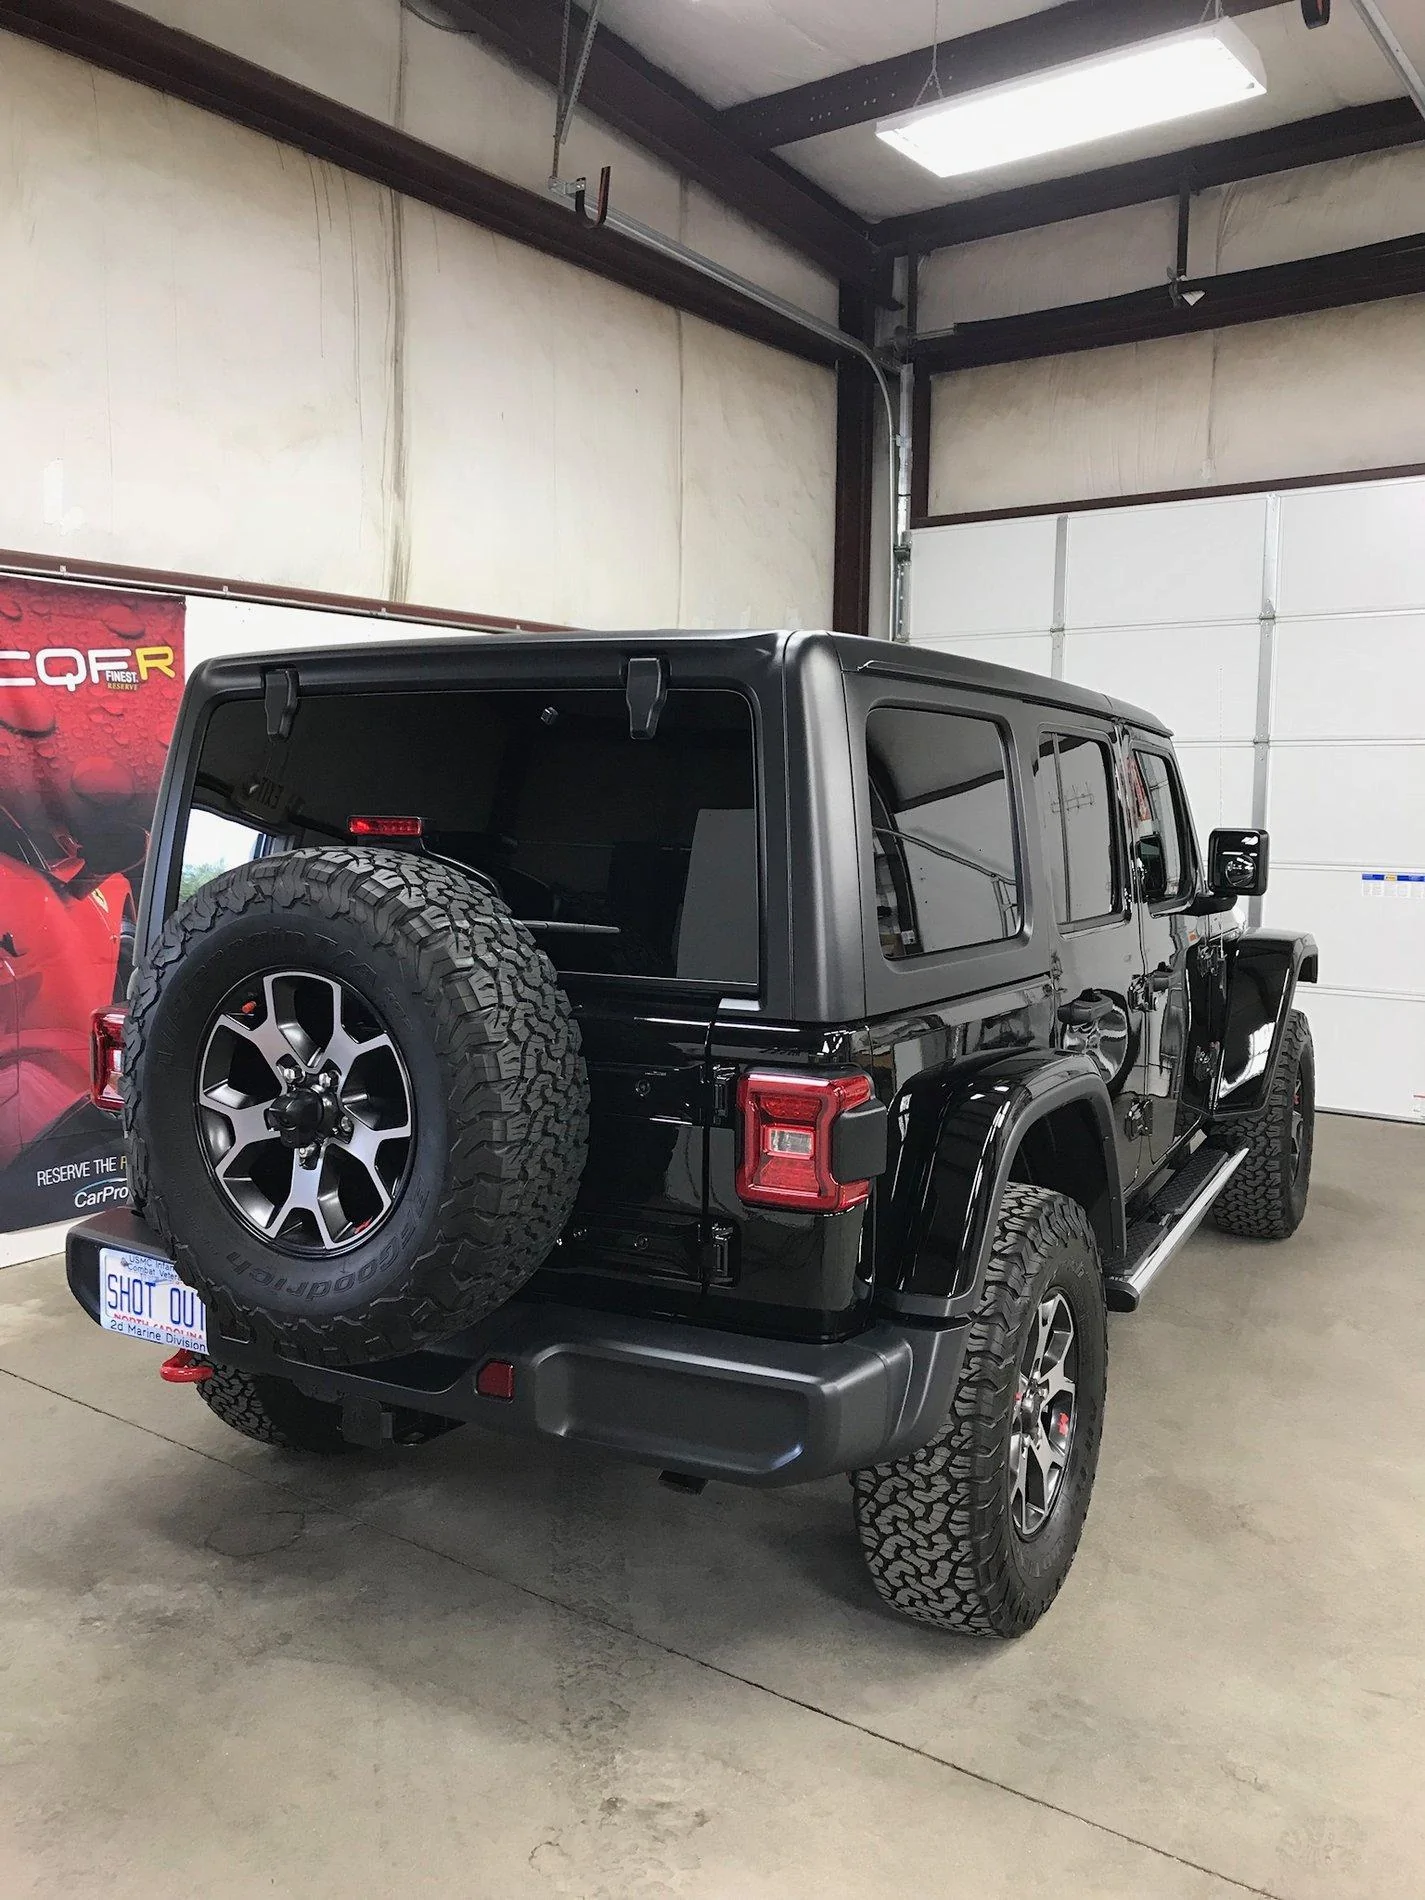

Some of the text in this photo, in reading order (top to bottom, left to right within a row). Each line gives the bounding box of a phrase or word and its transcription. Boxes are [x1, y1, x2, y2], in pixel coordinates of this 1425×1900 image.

[107, 683, 138, 691] RESERVE
[37, 1161, 90, 1187] RESERVE
[93, 1156, 117, 1176] THE
[128, 1262, 156, 1276] Combat
[129, 1255, 153, 1267] USMC
[108, 1274, 156, 1319] SHOT
[110, 1319, 206, 1353] 2d Marine Division
